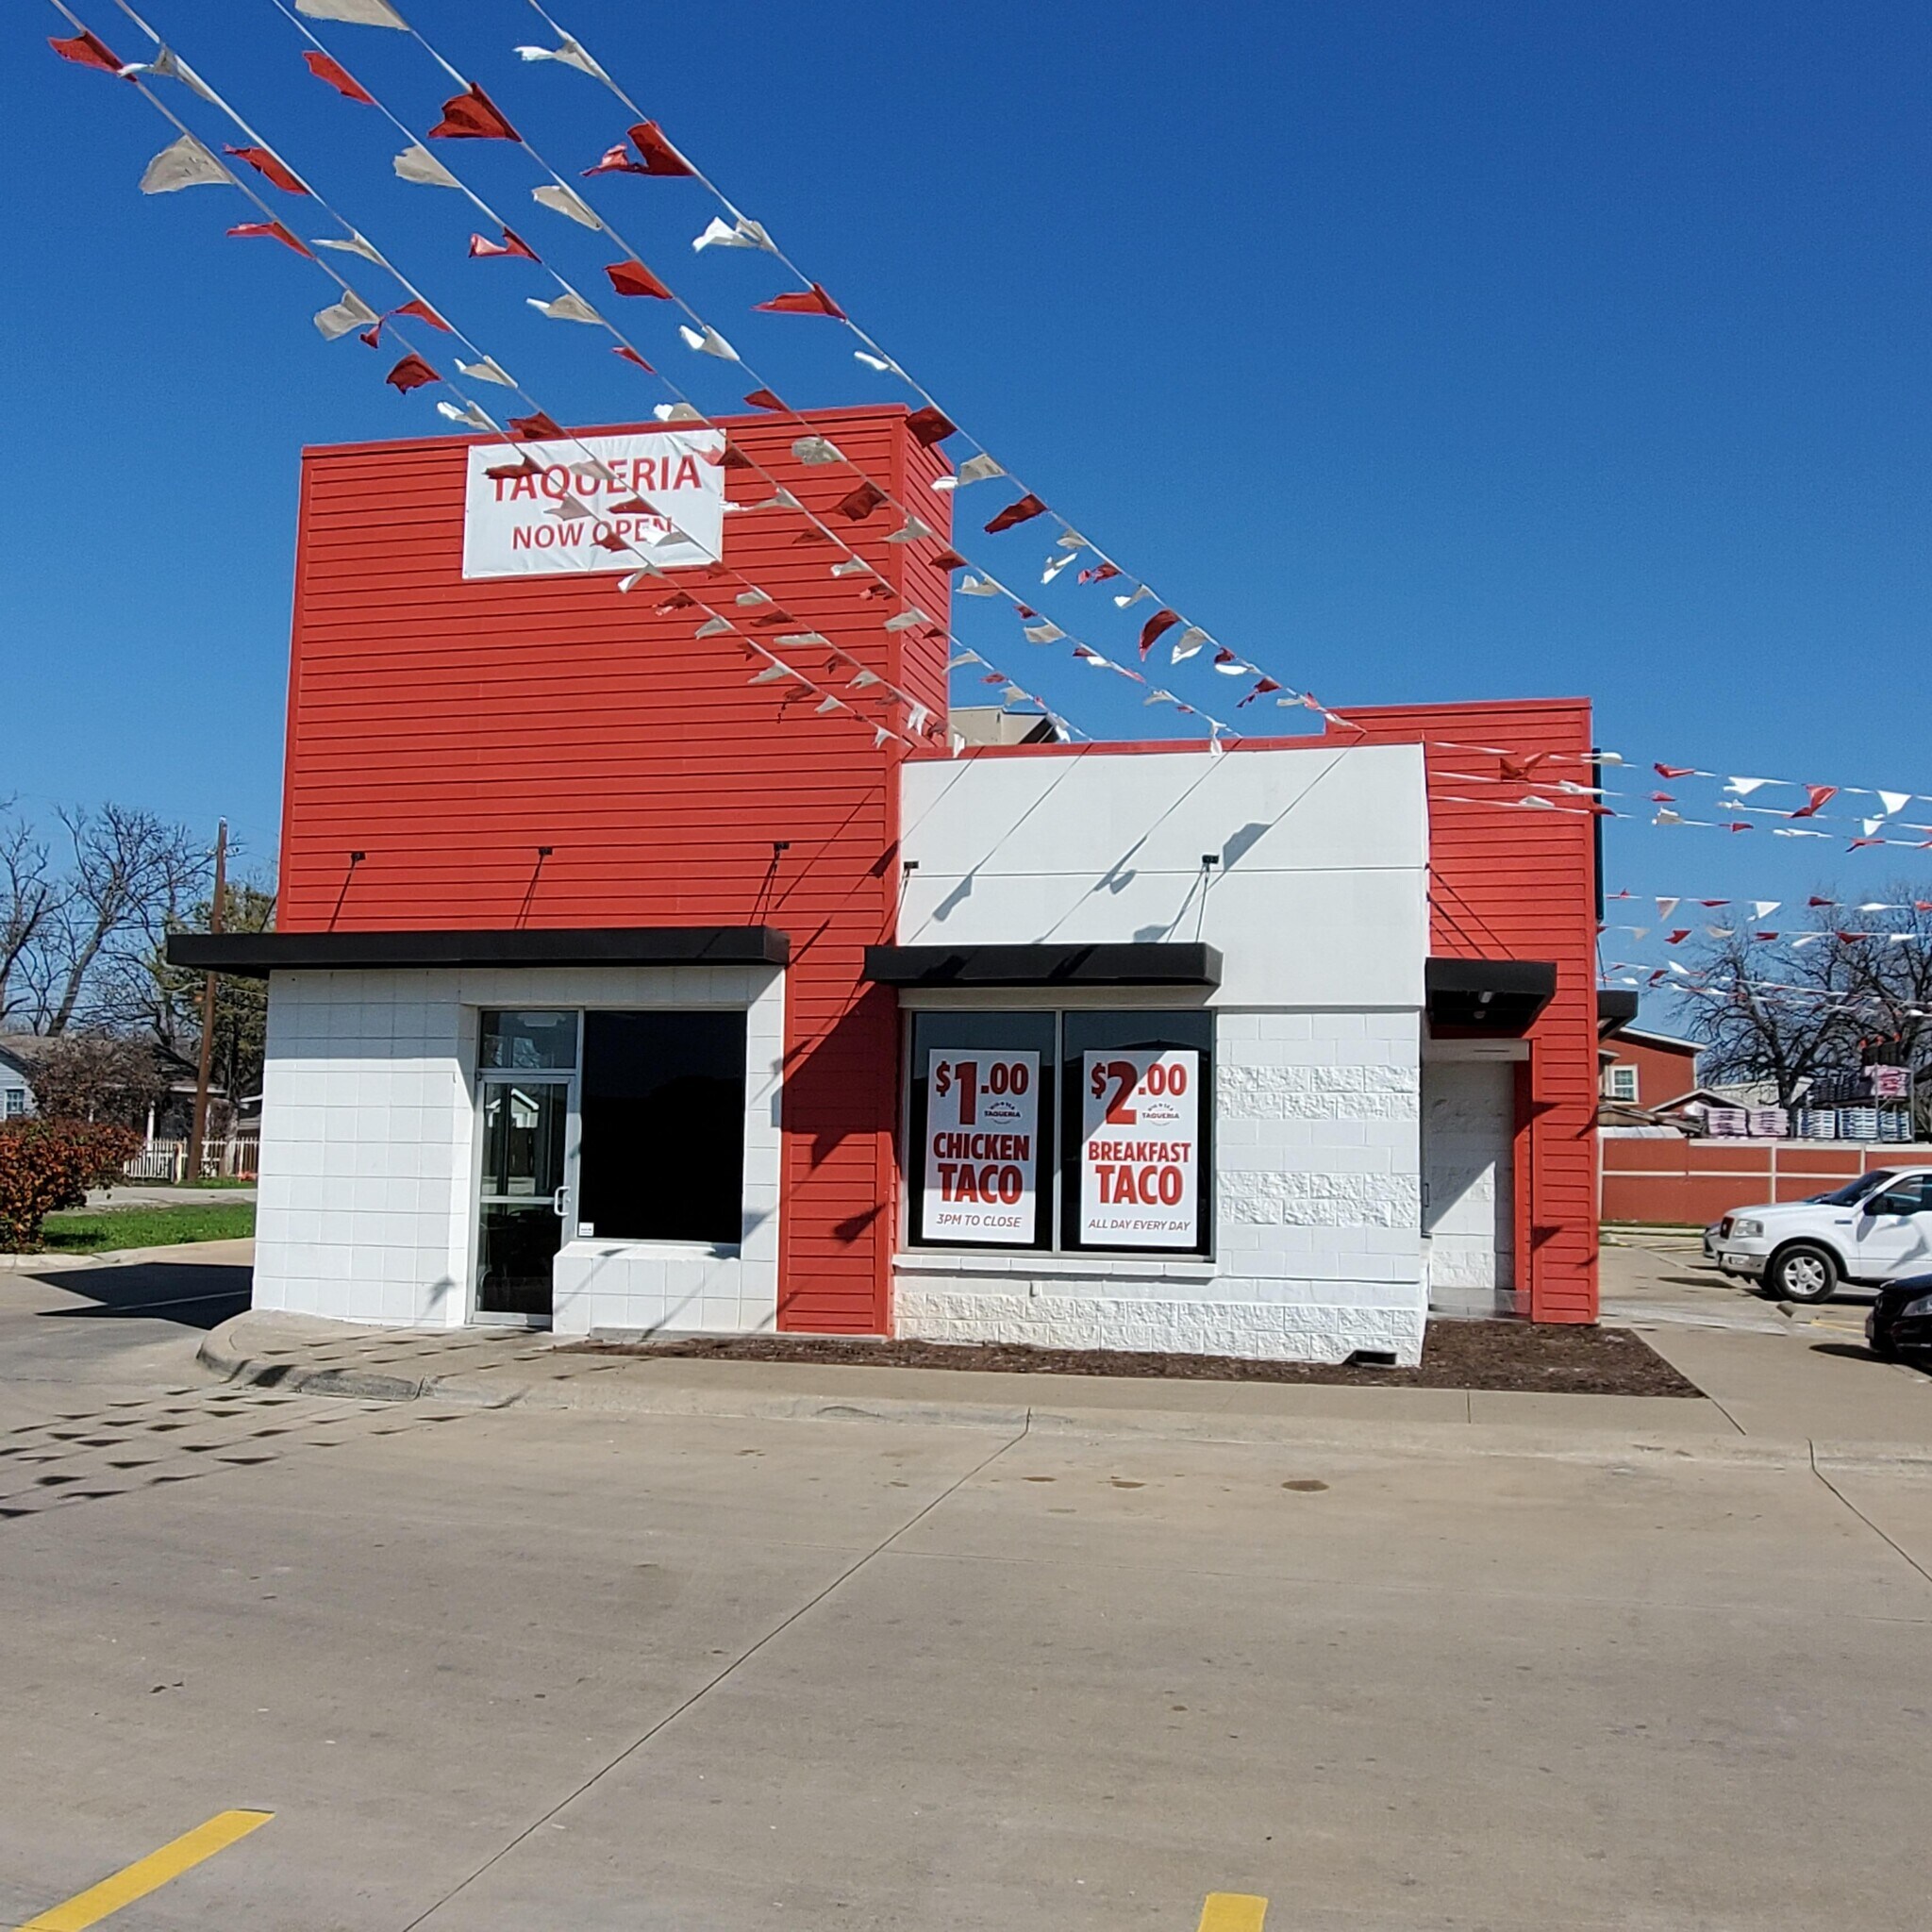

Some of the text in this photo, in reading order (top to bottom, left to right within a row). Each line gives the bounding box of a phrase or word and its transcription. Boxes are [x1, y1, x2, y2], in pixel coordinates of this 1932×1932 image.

[512, 517, 672, 550] NOW OPEN
[936, 1060, 1029, 1125] $1.00
[1091, 1060, 1188, 1125] $2.00
[933, 1131, 1030, 1161] CHICKEN
[1088, 1141, 1191, 1163] BREAKFAST
[937, 1162, 1024, 1205] TACO
[1094, 1164, 1184, 1206] TACO
[936, 1213, 1022, 1228] 3PM TO CLOSE
[1088, 1219, 1191, 1231] ALL DAY EVERY DAY
